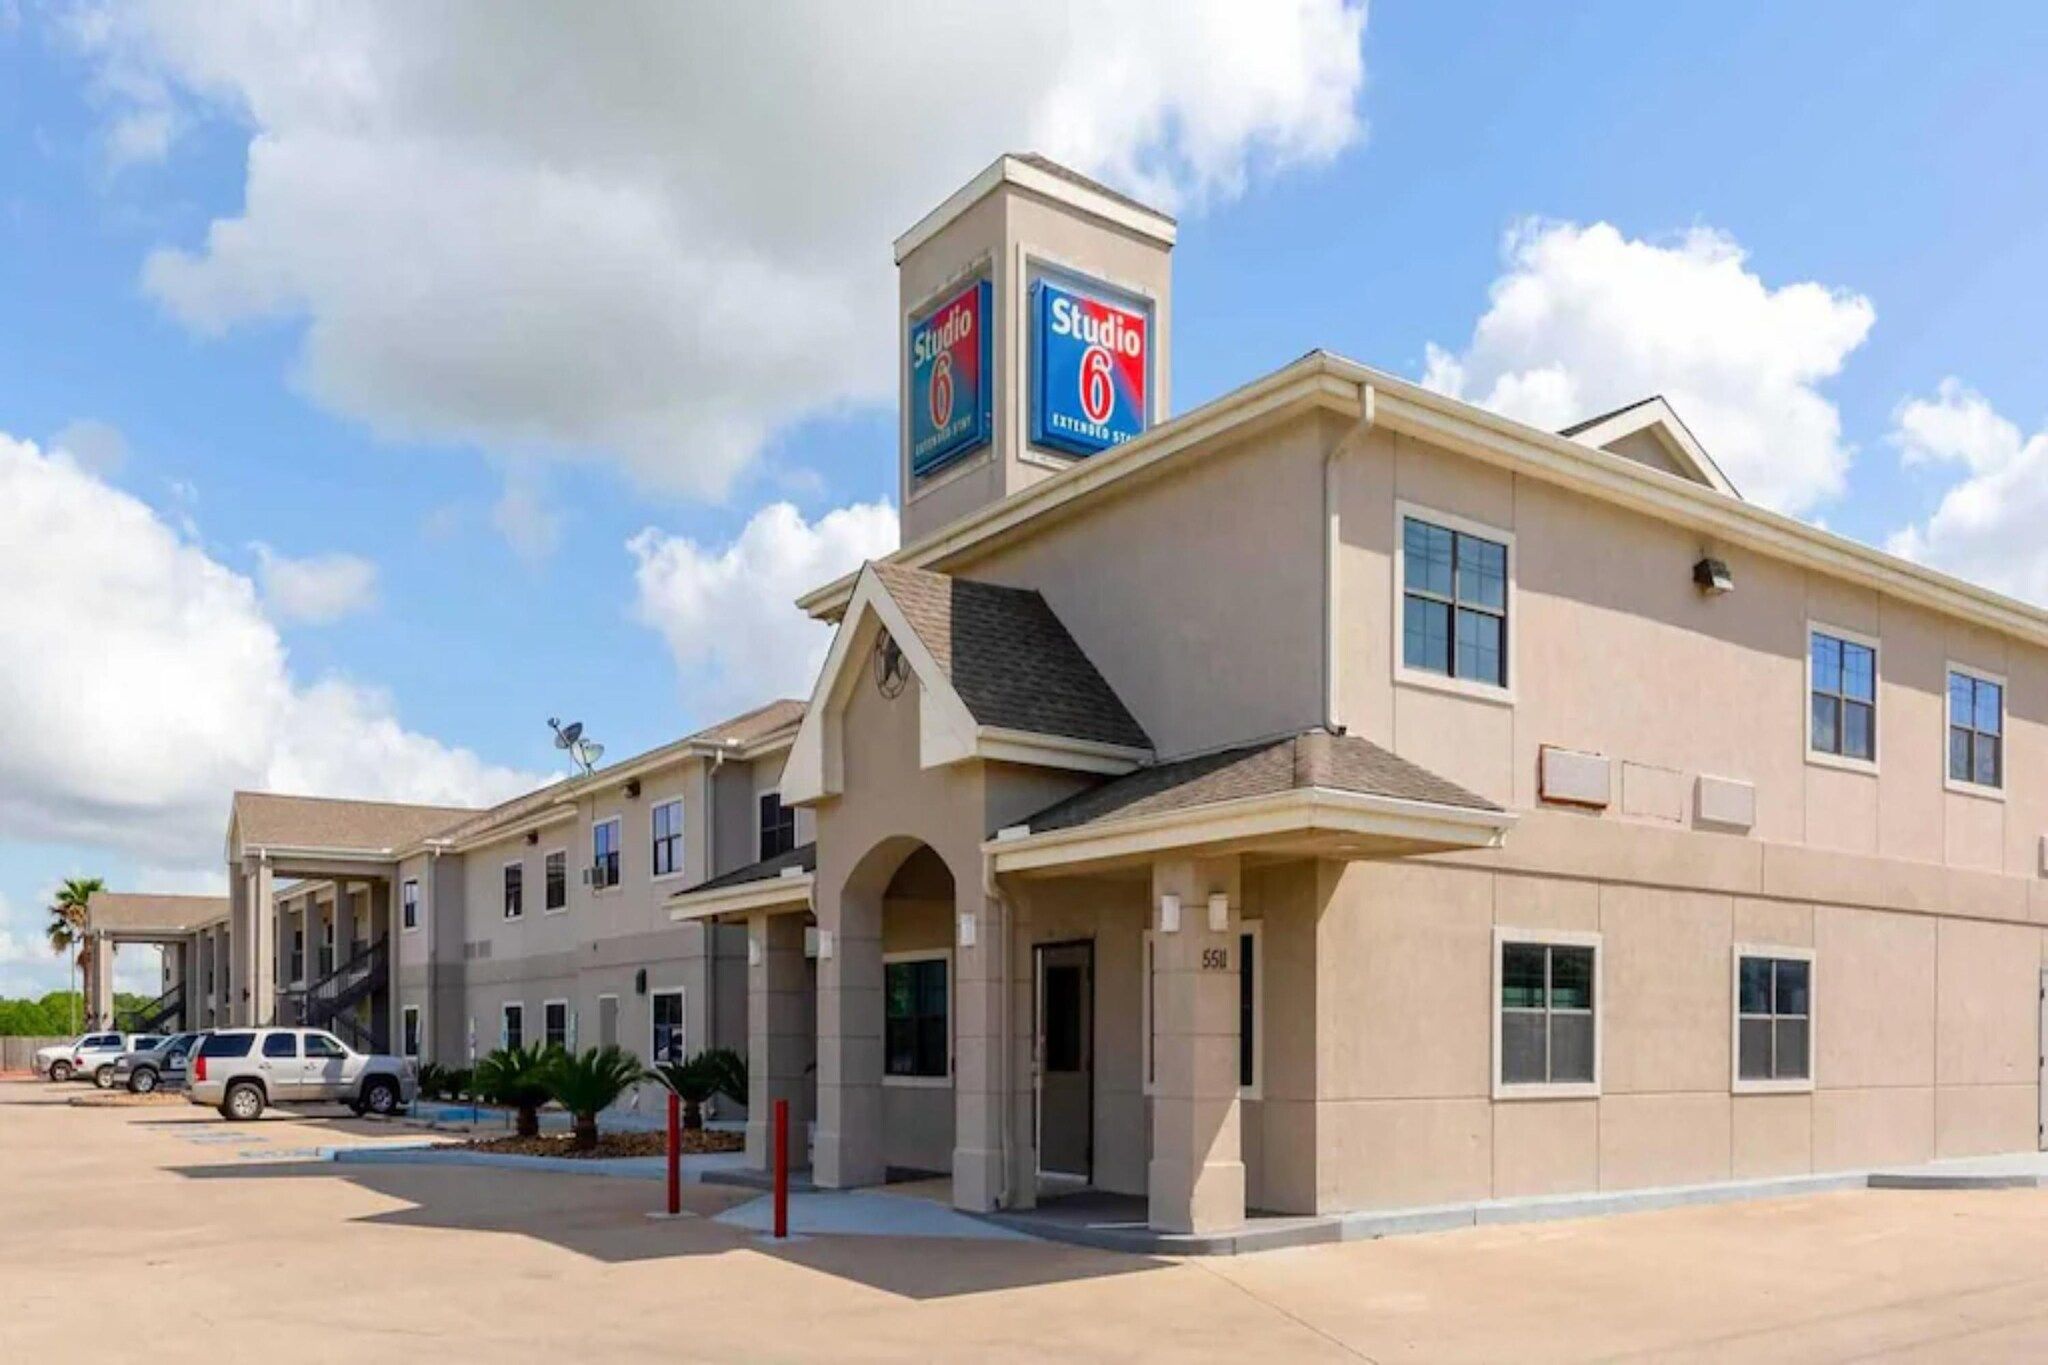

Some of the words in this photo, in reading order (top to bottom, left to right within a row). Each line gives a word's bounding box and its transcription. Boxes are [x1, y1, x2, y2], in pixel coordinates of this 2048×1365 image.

[914, 304, 971, 368] Studio
[1051, 297, 1141, 357] Studio
[931, 350, 953, 428] 6
[1079, 345, 1115, 425] 6
[1053, 412, 1109, 440] EXTENDED
[1202, 948, 1227, 969] 5511
